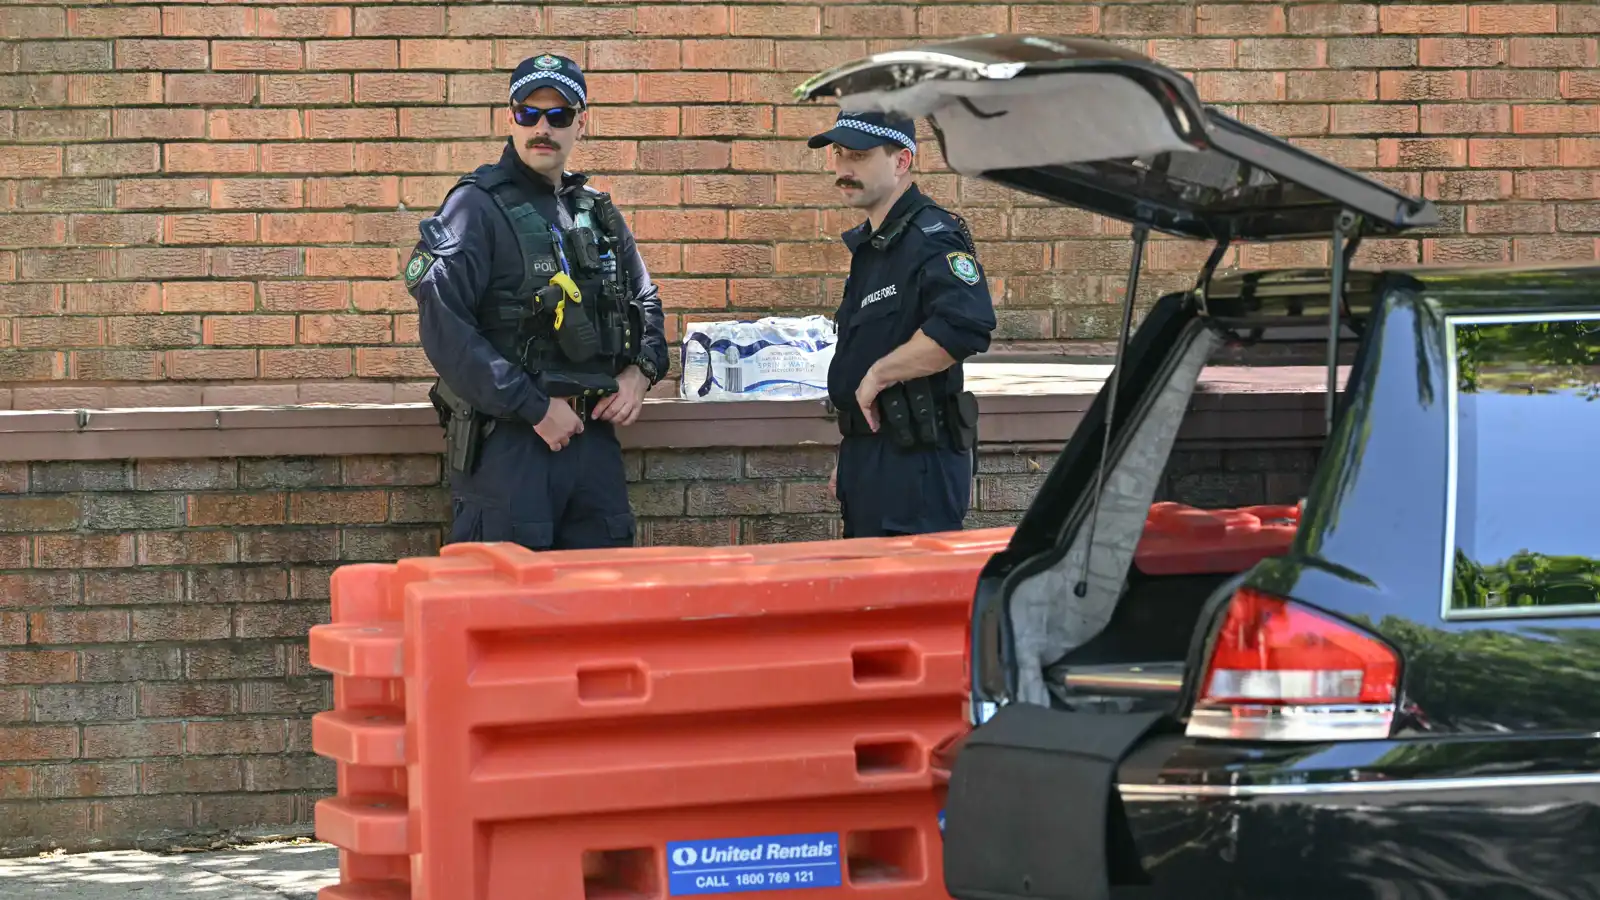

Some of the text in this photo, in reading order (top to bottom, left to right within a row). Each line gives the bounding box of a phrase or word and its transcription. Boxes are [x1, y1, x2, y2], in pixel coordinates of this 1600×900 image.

[881, 284, 897, 299] FORCE
[701, 840, 833, 864] United Rentals
[696, 871, 814, 888] CALL 1800 769 121
